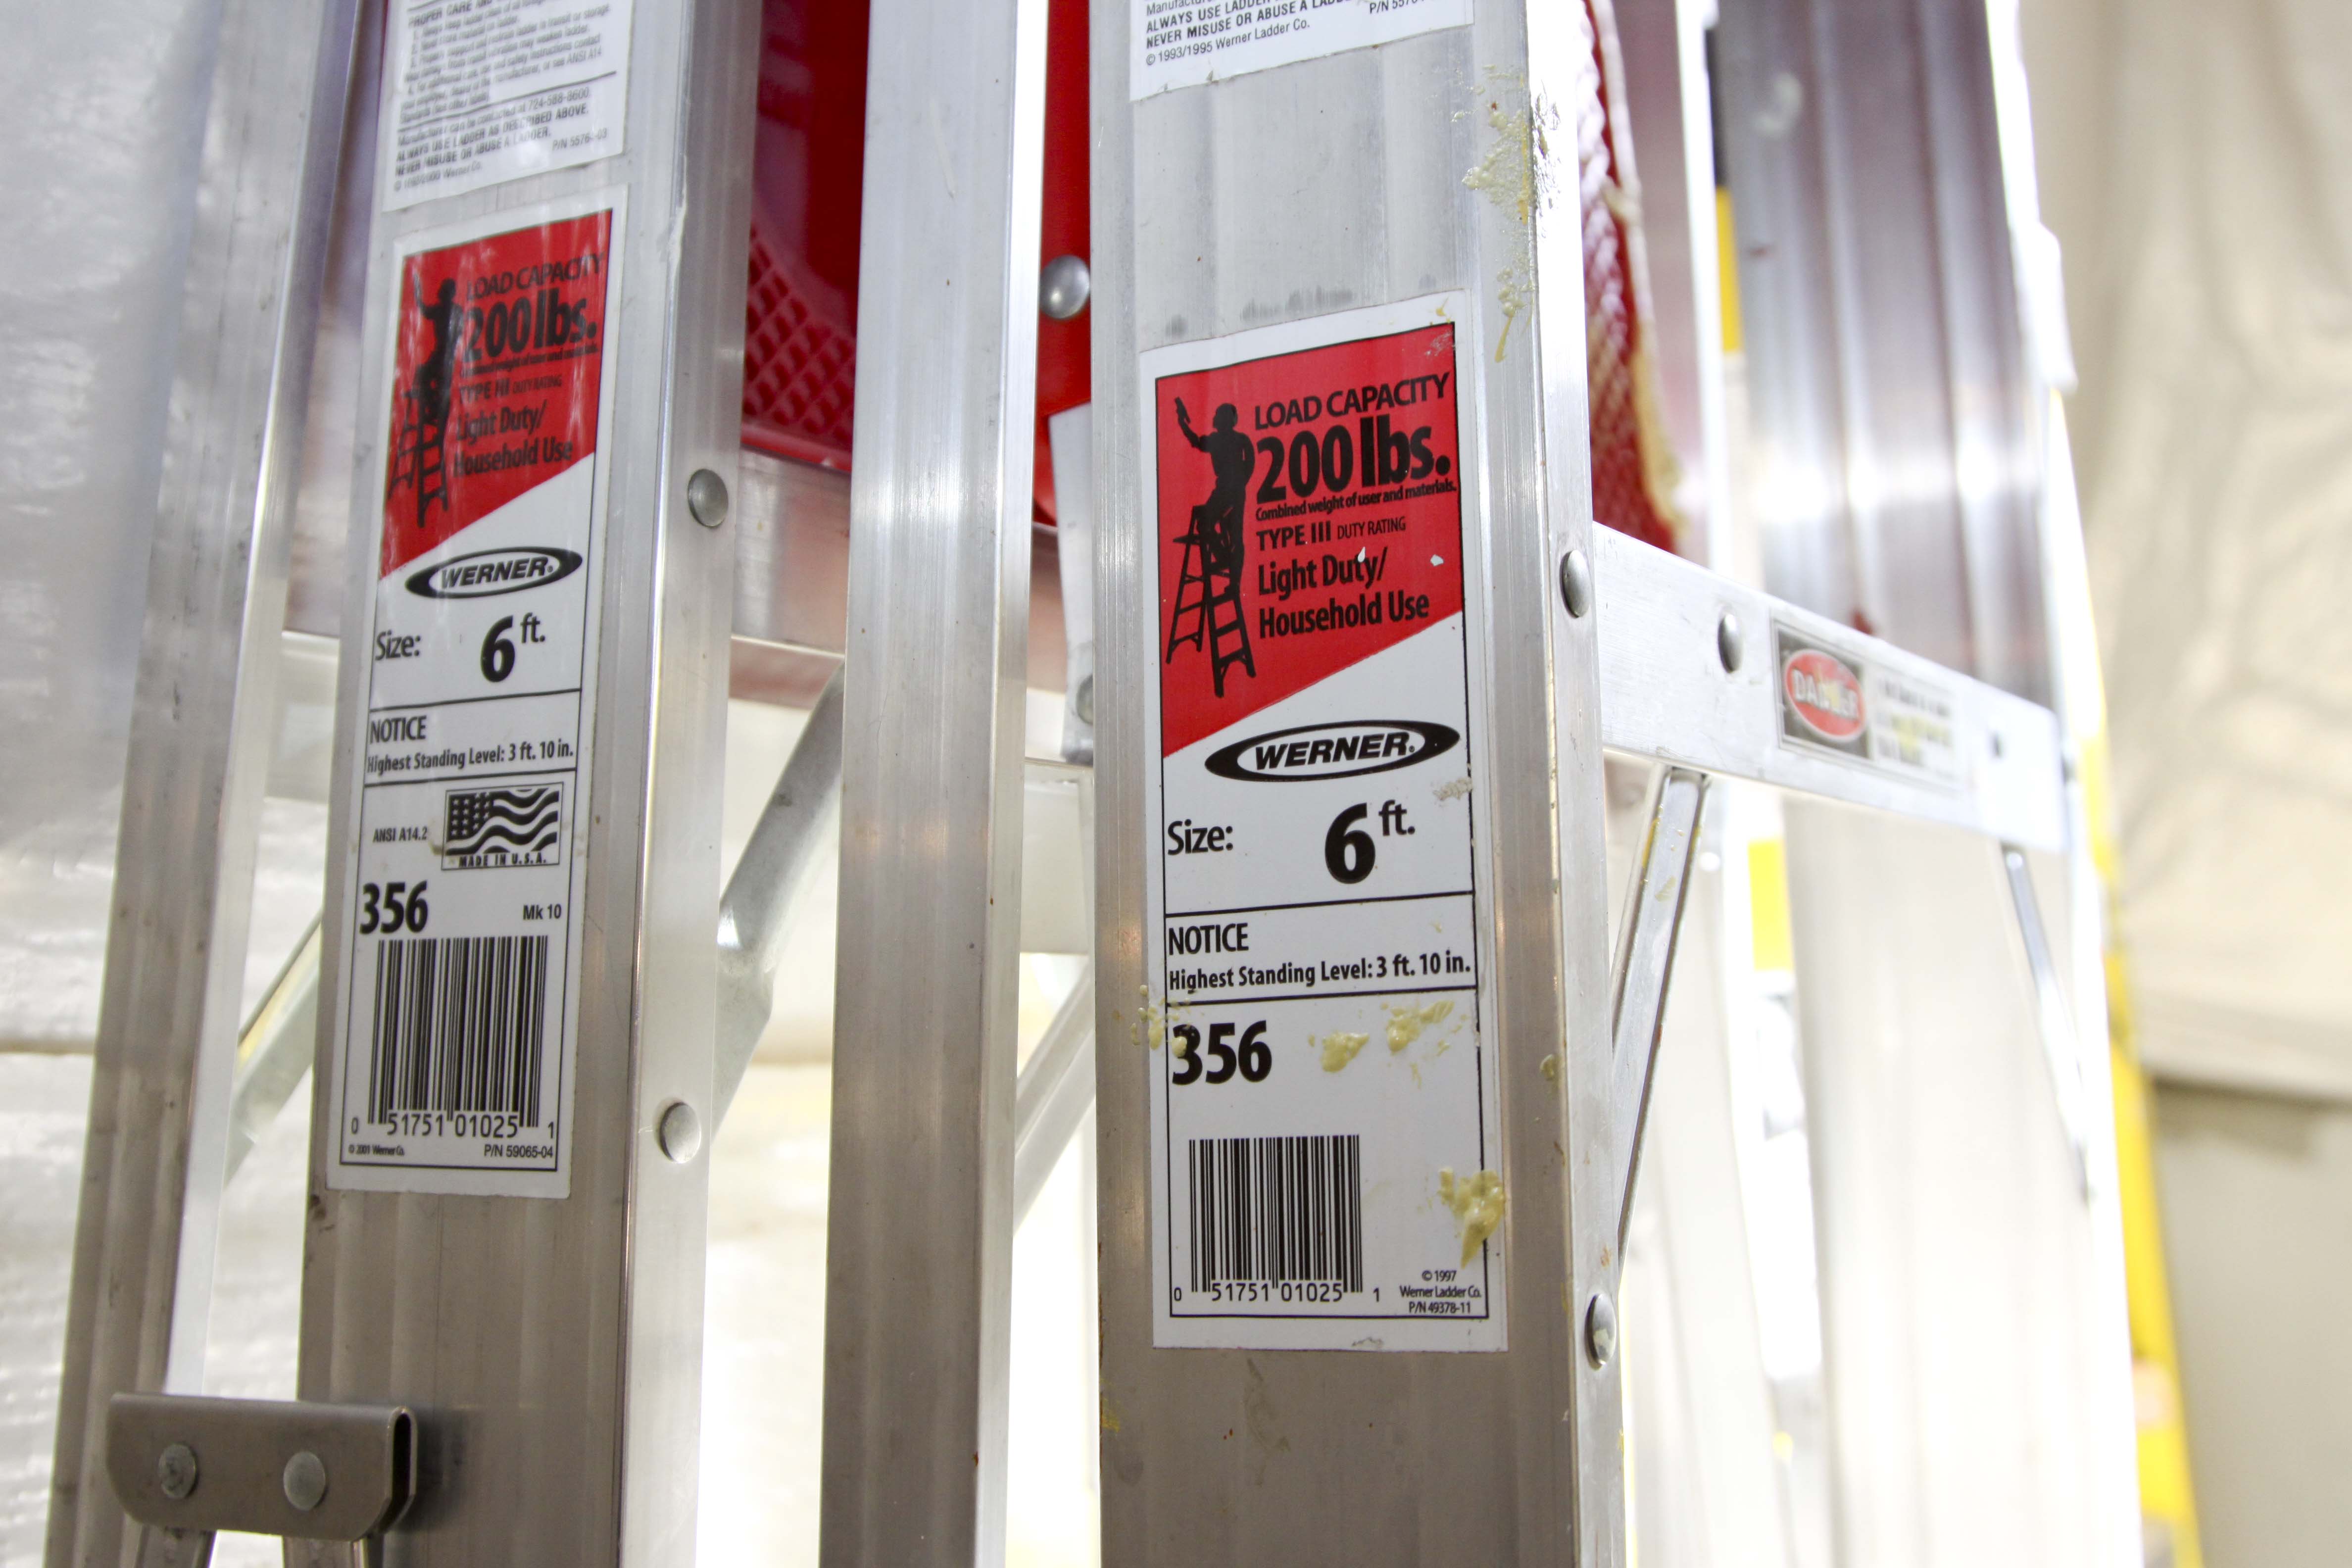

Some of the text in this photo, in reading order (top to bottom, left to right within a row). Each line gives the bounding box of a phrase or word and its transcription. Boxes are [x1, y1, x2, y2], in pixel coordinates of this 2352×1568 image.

[1146, 11, 1192, 33] ALWAYS
[1198, 4, 1221, 20] USE
[1146, 29, 1182, 49] NEVER
[1187, 18, 1231, 38] MISUSE
[1236, 12, 1252, 26] OR
[1257, 1, 1296, 21] ABUSE
[1300, 0, 1307, 11] A
[1370, 1, 1388, 13] P/N
[1159, 41, 1213, 61] 1993/1995
[1216, 32, 1252, 49] Werner
[1255, 23, 1290, 39] Ladder
[1293, 18, 1310, 30] Co.
[396, 142, 429, 162] ALWAYS
[432, 137, 451, 151] USE
[453, 128, 485, 147] LADDER
[488, 123, 499, 136] AS
[555, 102, 589, 120] ABOVE.
[395, 159, 421, 176] NEVER
[424, 150, 457, 166] MISUSE
[460, 147, 472, 160] OR
[475, 138, 502, 155] ABUSE
[467, 251, 604, 302] LOAD CAPACITY
[464, 288, 597, 362] 200 lbs.
[460, 381, 491, 404] TYPE
[1255, 372, 1450, 430] LOAD CAPACITY
[456, 399, 547, 445] Light Duty/
[454, 437, 573, 478] Household Use
[1256, 414, 1451, 504] 200 lbs.
[1256, 478, 1457, 522] Combined weight of user and materials.
[1256, 516, 1406, 551] TYPE III DUTY RATING
[1258, 546, 1387, 600] Light Duty/
[1260, 590, 1429, 639] Household Use
[375, 612, 545, 683] Size: 6 ft.
[370, 716, 427, 744] NOTICE
[368, 738, 573, 776] Highest Standing Level: 3 ft. 10 in.
[373, 826, 427, 843] ANSI A14.2
[1168, 799, 1416, 884] Size: 6 ft.
[459, 852, 546, 868] MADE IN U.S.A.
[359, 881, 428, 934] 356
[523, 904, 561, 921] Mk 10
[1168, 922, 1249, 955] NOTICE
[1169, 949, 1470, 994] Highest Standing Level: 3 ft. 10 in.
[1172, 1020, 1272, 1085] 356
[351, 1117, 359, 1134] 0
[387, 1113, 443, 1136] 51751
[455, 1114, 518, 1138] 01025
[484, 1144, 553, 1158] P/N 59065-04
[1174, 1283, 1379, 1302] 0 51751 01025 1
[1400, 1285, 1481, 1298] Werner Ladder Co.
[1434, 1270, 1457, 1282] 1997
[1409, 1302, 1471, 1314] P/N 49378-11
